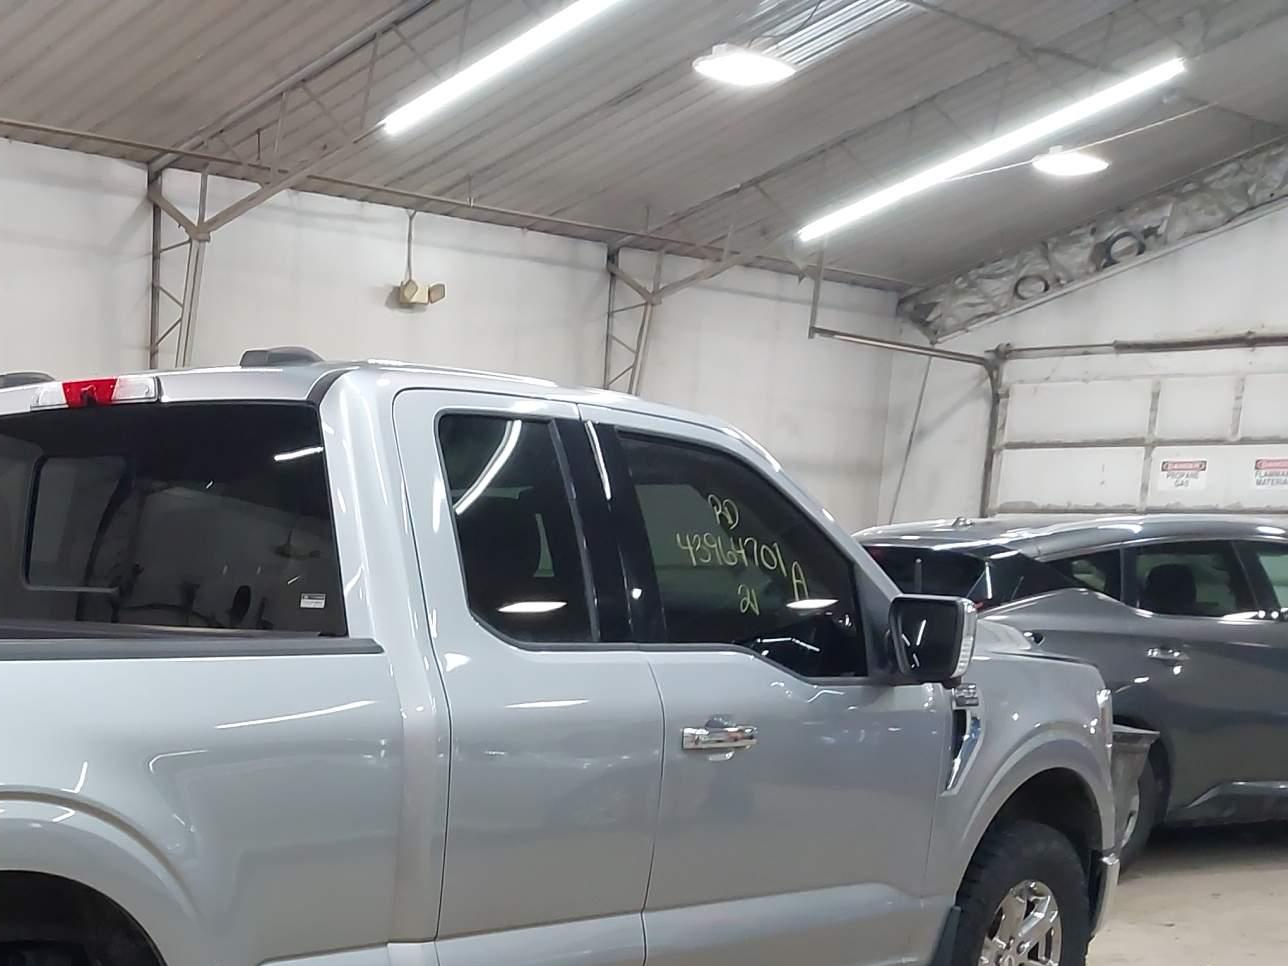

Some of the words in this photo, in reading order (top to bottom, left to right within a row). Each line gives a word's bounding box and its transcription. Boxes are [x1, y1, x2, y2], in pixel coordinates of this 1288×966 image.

[1174, 479, 1189, 488] GAS
[676, 532, 787, 577] 43964701
[791, 561, 809, 601] A
